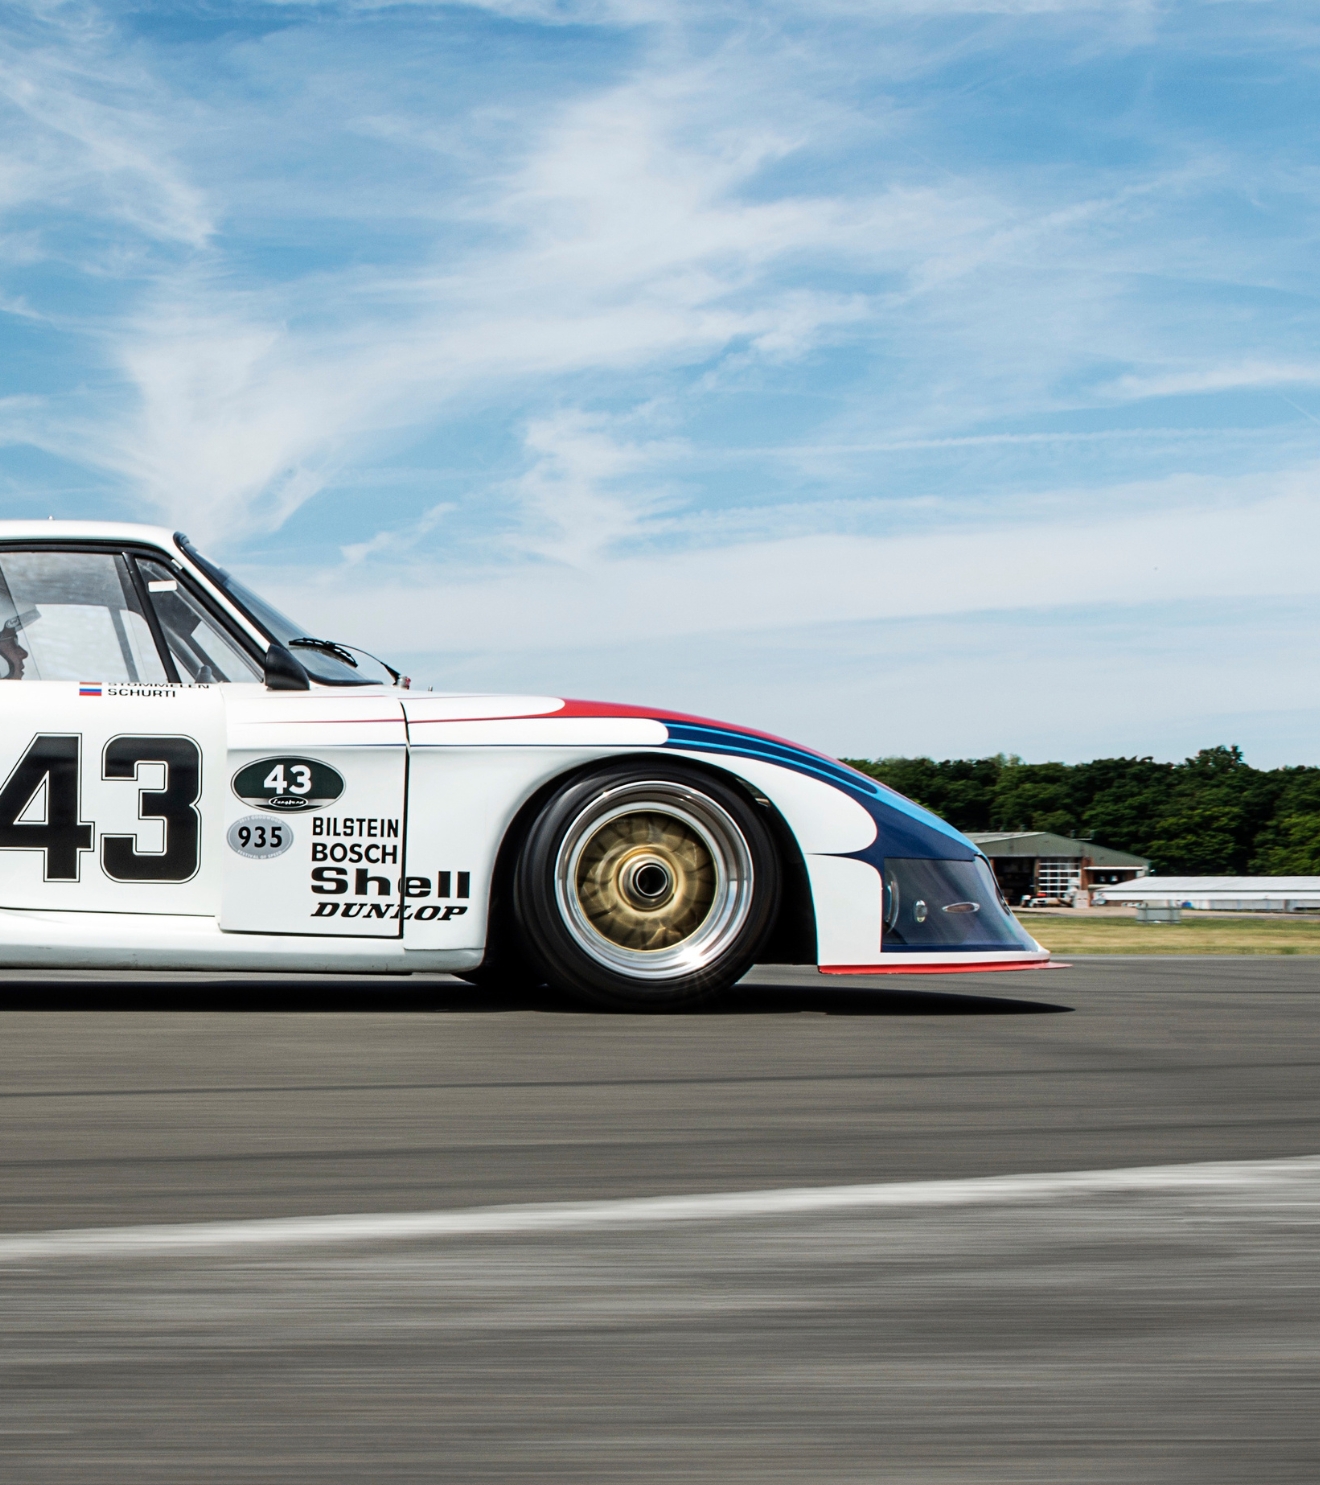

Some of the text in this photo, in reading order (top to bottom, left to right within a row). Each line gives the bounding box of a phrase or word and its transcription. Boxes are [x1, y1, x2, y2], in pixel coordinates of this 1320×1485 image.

[108, 688, 177, 698] SCHURTI
[263, 764, 312, 795] 43
[238, 826, 283, 848] 935
[312, 817, 399, 838] BILSTEIN
[311, 842, 398, 864] BOSCH
[311, 866, 470, 899] Shell
[310, 902, 468, 921] DUNLOP
